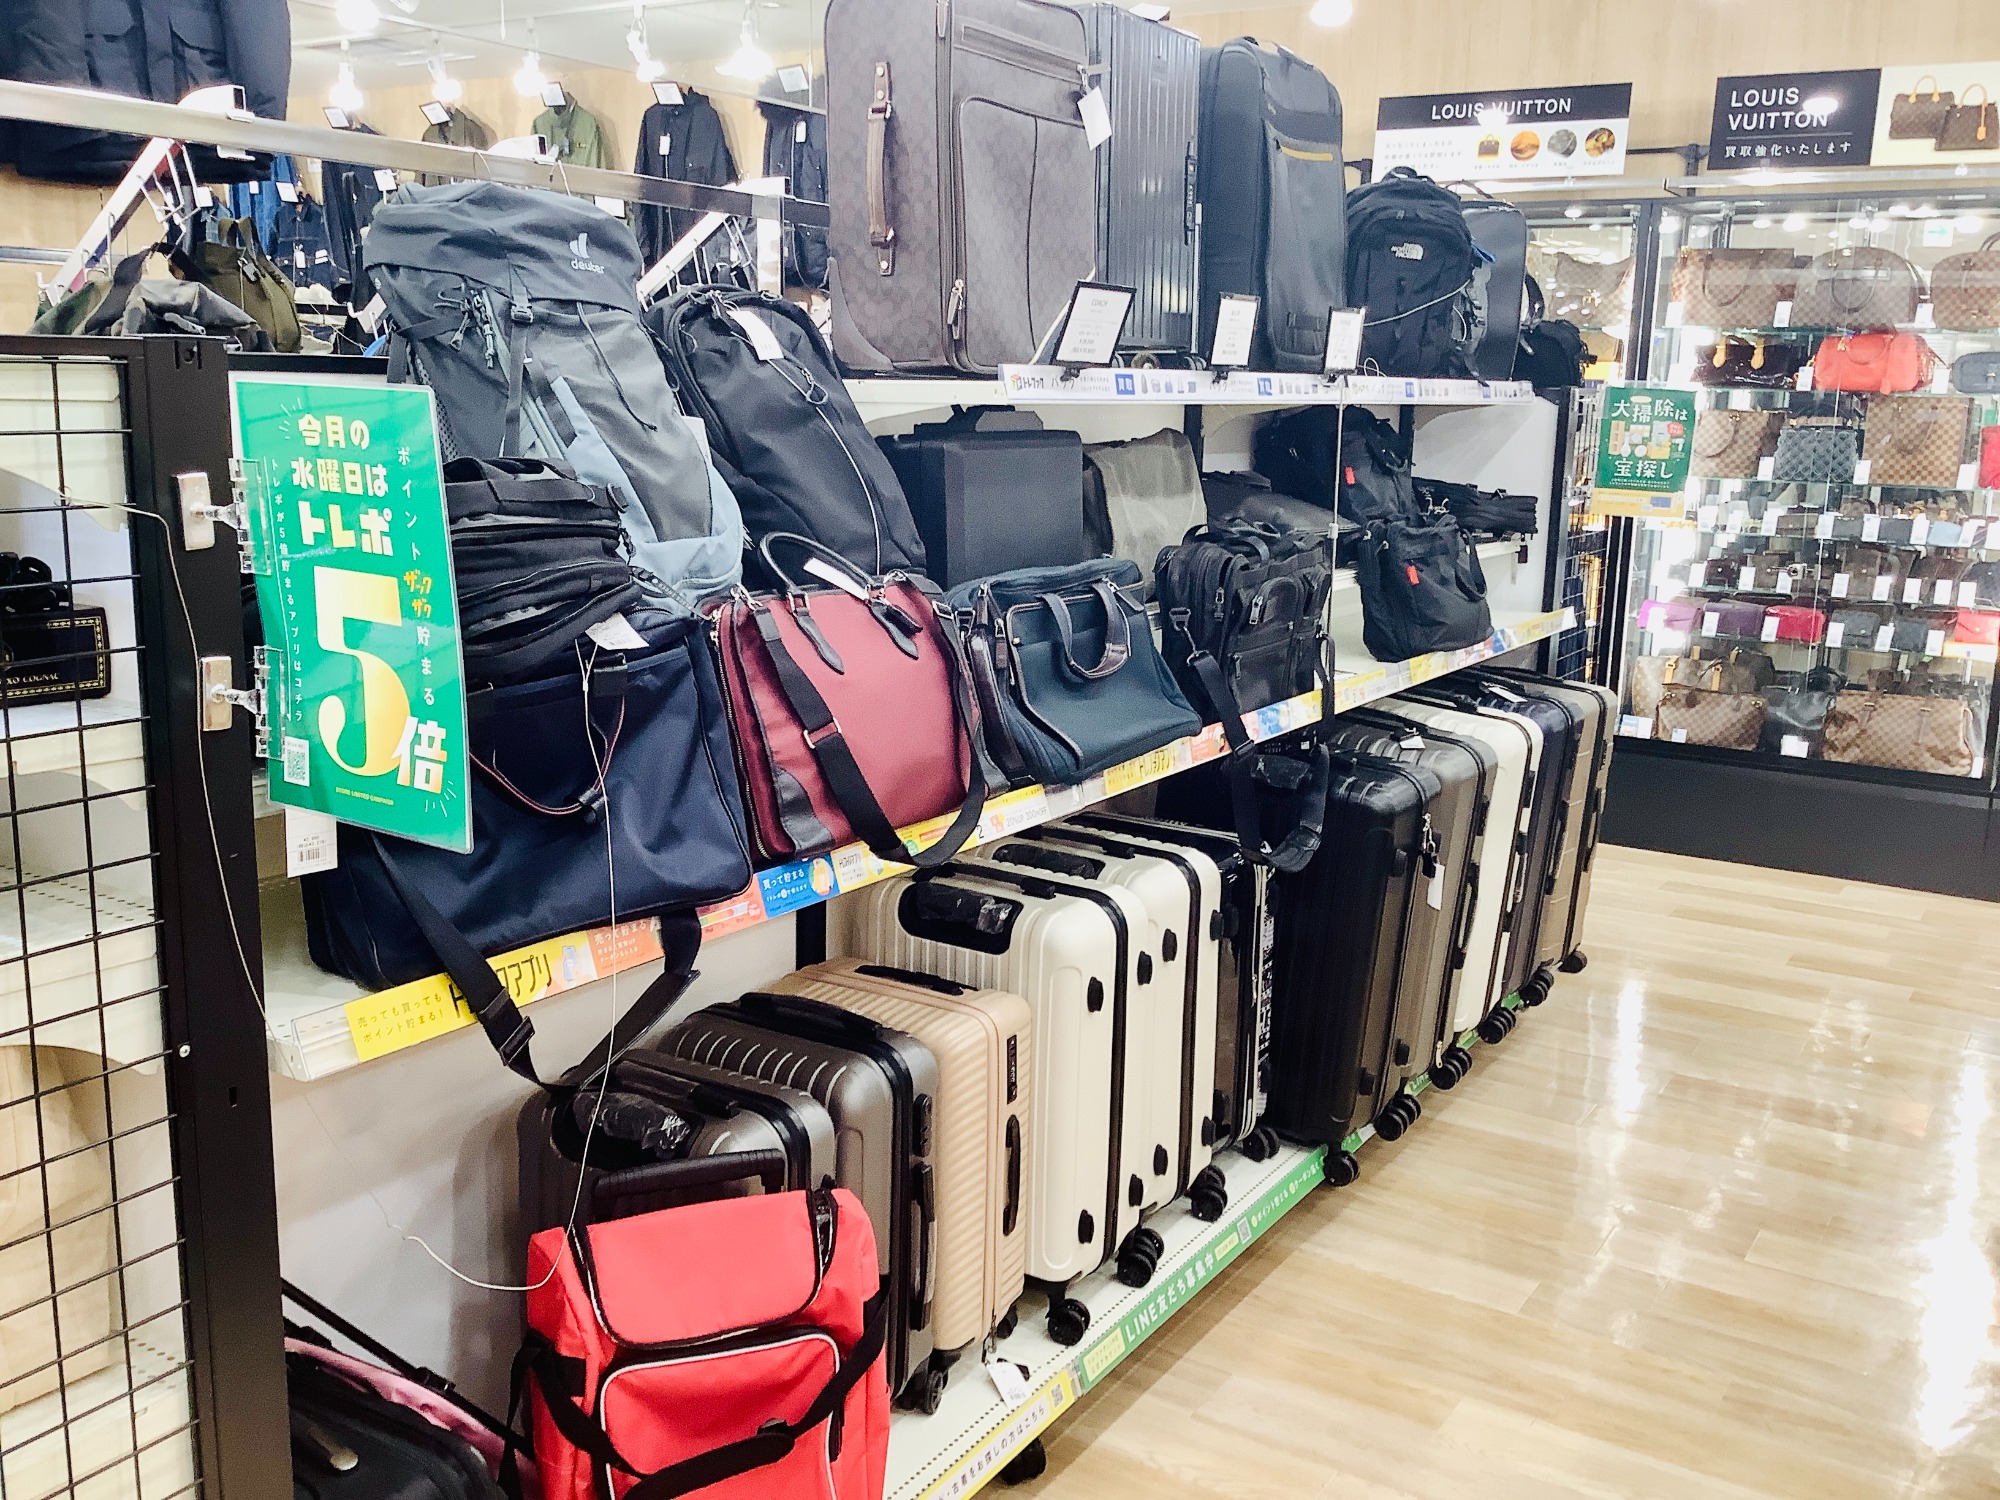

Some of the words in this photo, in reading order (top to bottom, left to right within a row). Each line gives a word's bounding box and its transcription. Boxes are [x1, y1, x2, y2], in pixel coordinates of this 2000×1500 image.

[1731, 87, 1799, 107] LOUIS
[1431, 102, 1484, 120] LOUIS
[1728, 110, 1829, 131] VUITTON
[1724, 142, 1852, 159] 買取強化いたします
[570, 257, 605, 275] deuter
[1611, 398, 1688, 423] 大掃除は
[298, 413, 371, 451] 今月の
[291, 456, 390, 498] 水曜日は
[1613, 457, 1674, 479] 宝探し
[297, 500, 395, 558] トレポ
[6, 675, 20, 685] XO
[22, 672, 59, 683] COGNAC
[762, 868, 805, 891] 買って貯まる
[593, 920, 647, 946] 売って貯まる
[357, 992, 442, 1028] 売っても買っても
[1125, 1252, 1214, 1343] LINE友だち募集中
